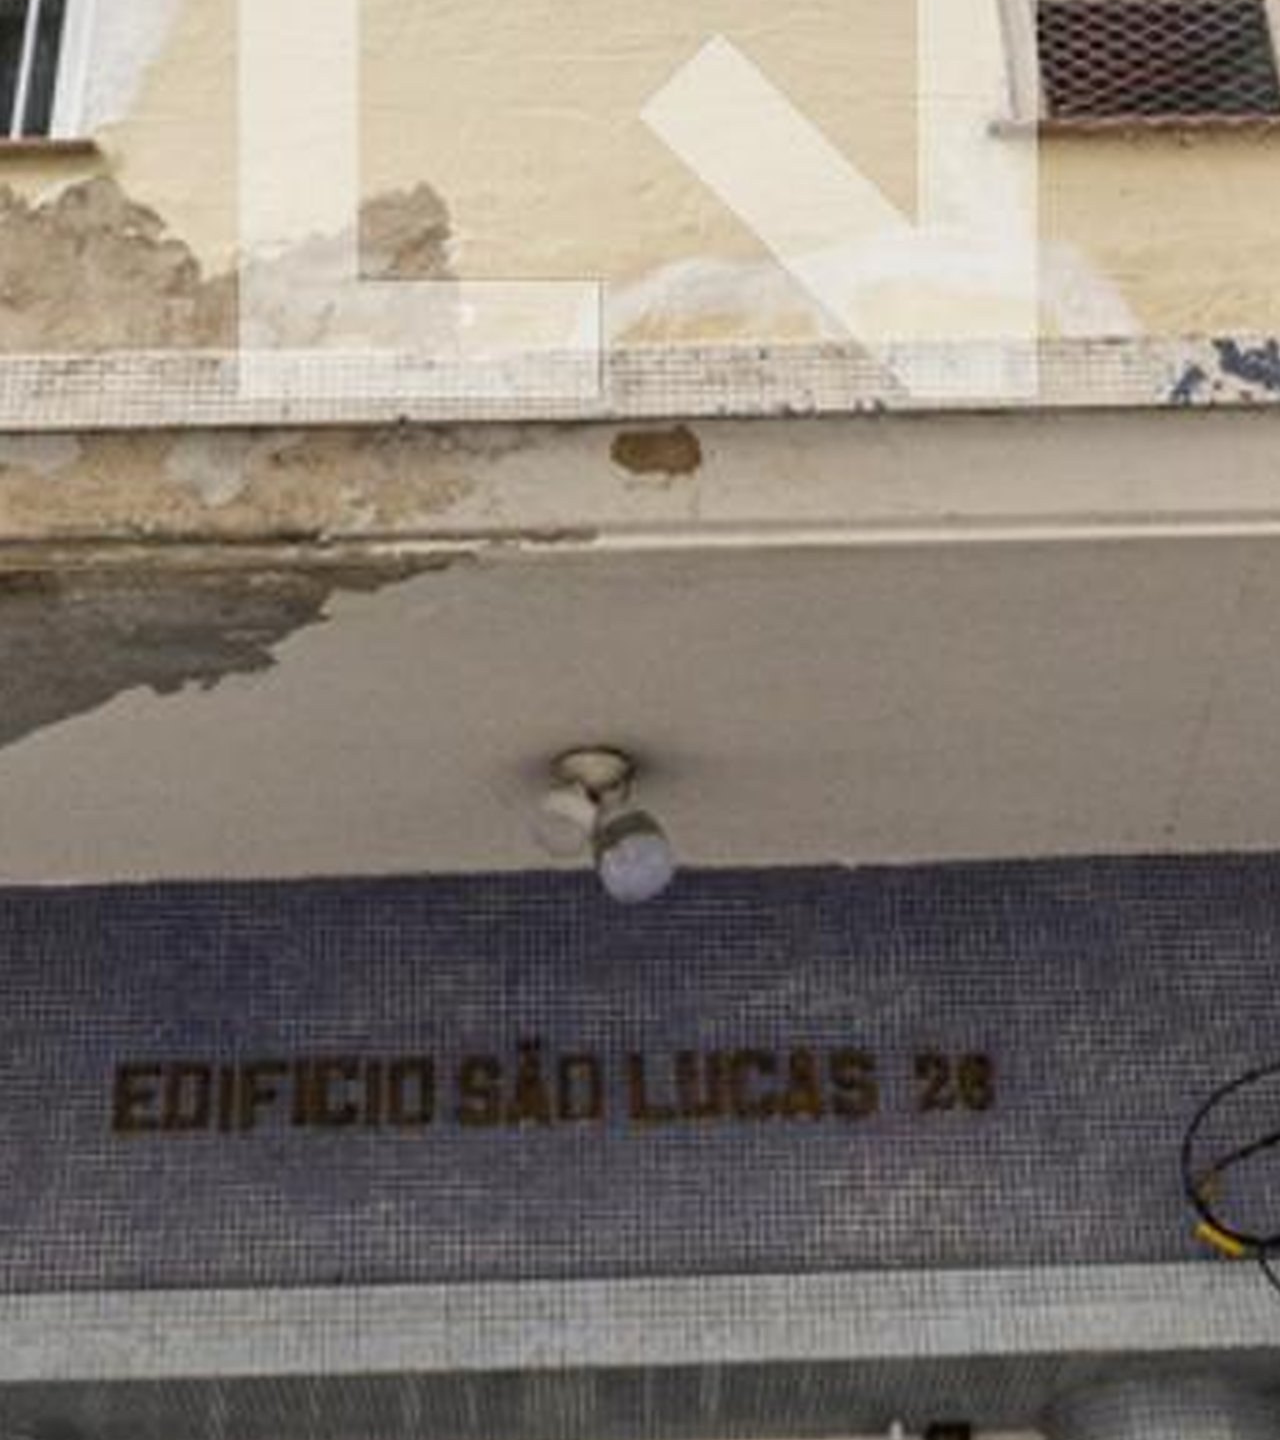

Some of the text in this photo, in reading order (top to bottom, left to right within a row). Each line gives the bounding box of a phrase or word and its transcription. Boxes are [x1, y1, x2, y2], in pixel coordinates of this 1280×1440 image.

[112, 1055, 434, 1132] EDIFICIO
[457, 1038, 605, 1126] SÃO
[627, 1046, 881, 1121] LUCAS
